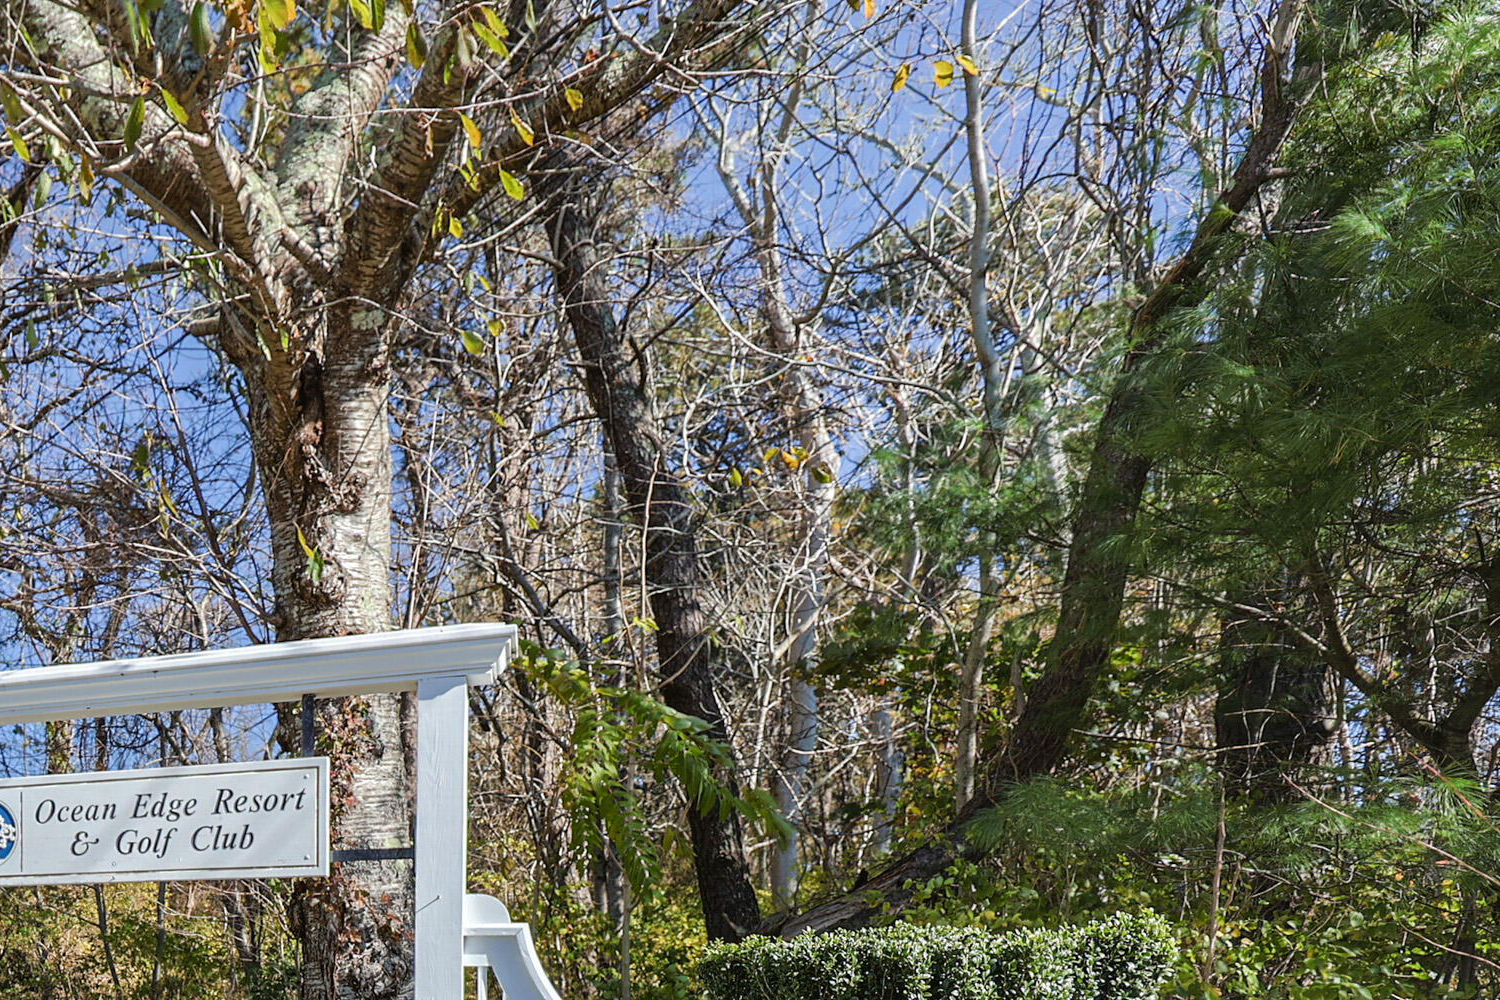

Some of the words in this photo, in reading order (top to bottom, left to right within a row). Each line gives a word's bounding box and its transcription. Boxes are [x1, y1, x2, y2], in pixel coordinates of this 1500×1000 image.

[34, 798, 117, 824] Ocean
[130, 791, 198, 821] Edge
[211, 787, 307, 815] Resort
[70, 830, 100, 856] &
[115, 827, 178, 858] Golf
[191, 824, 255, 851] Club
